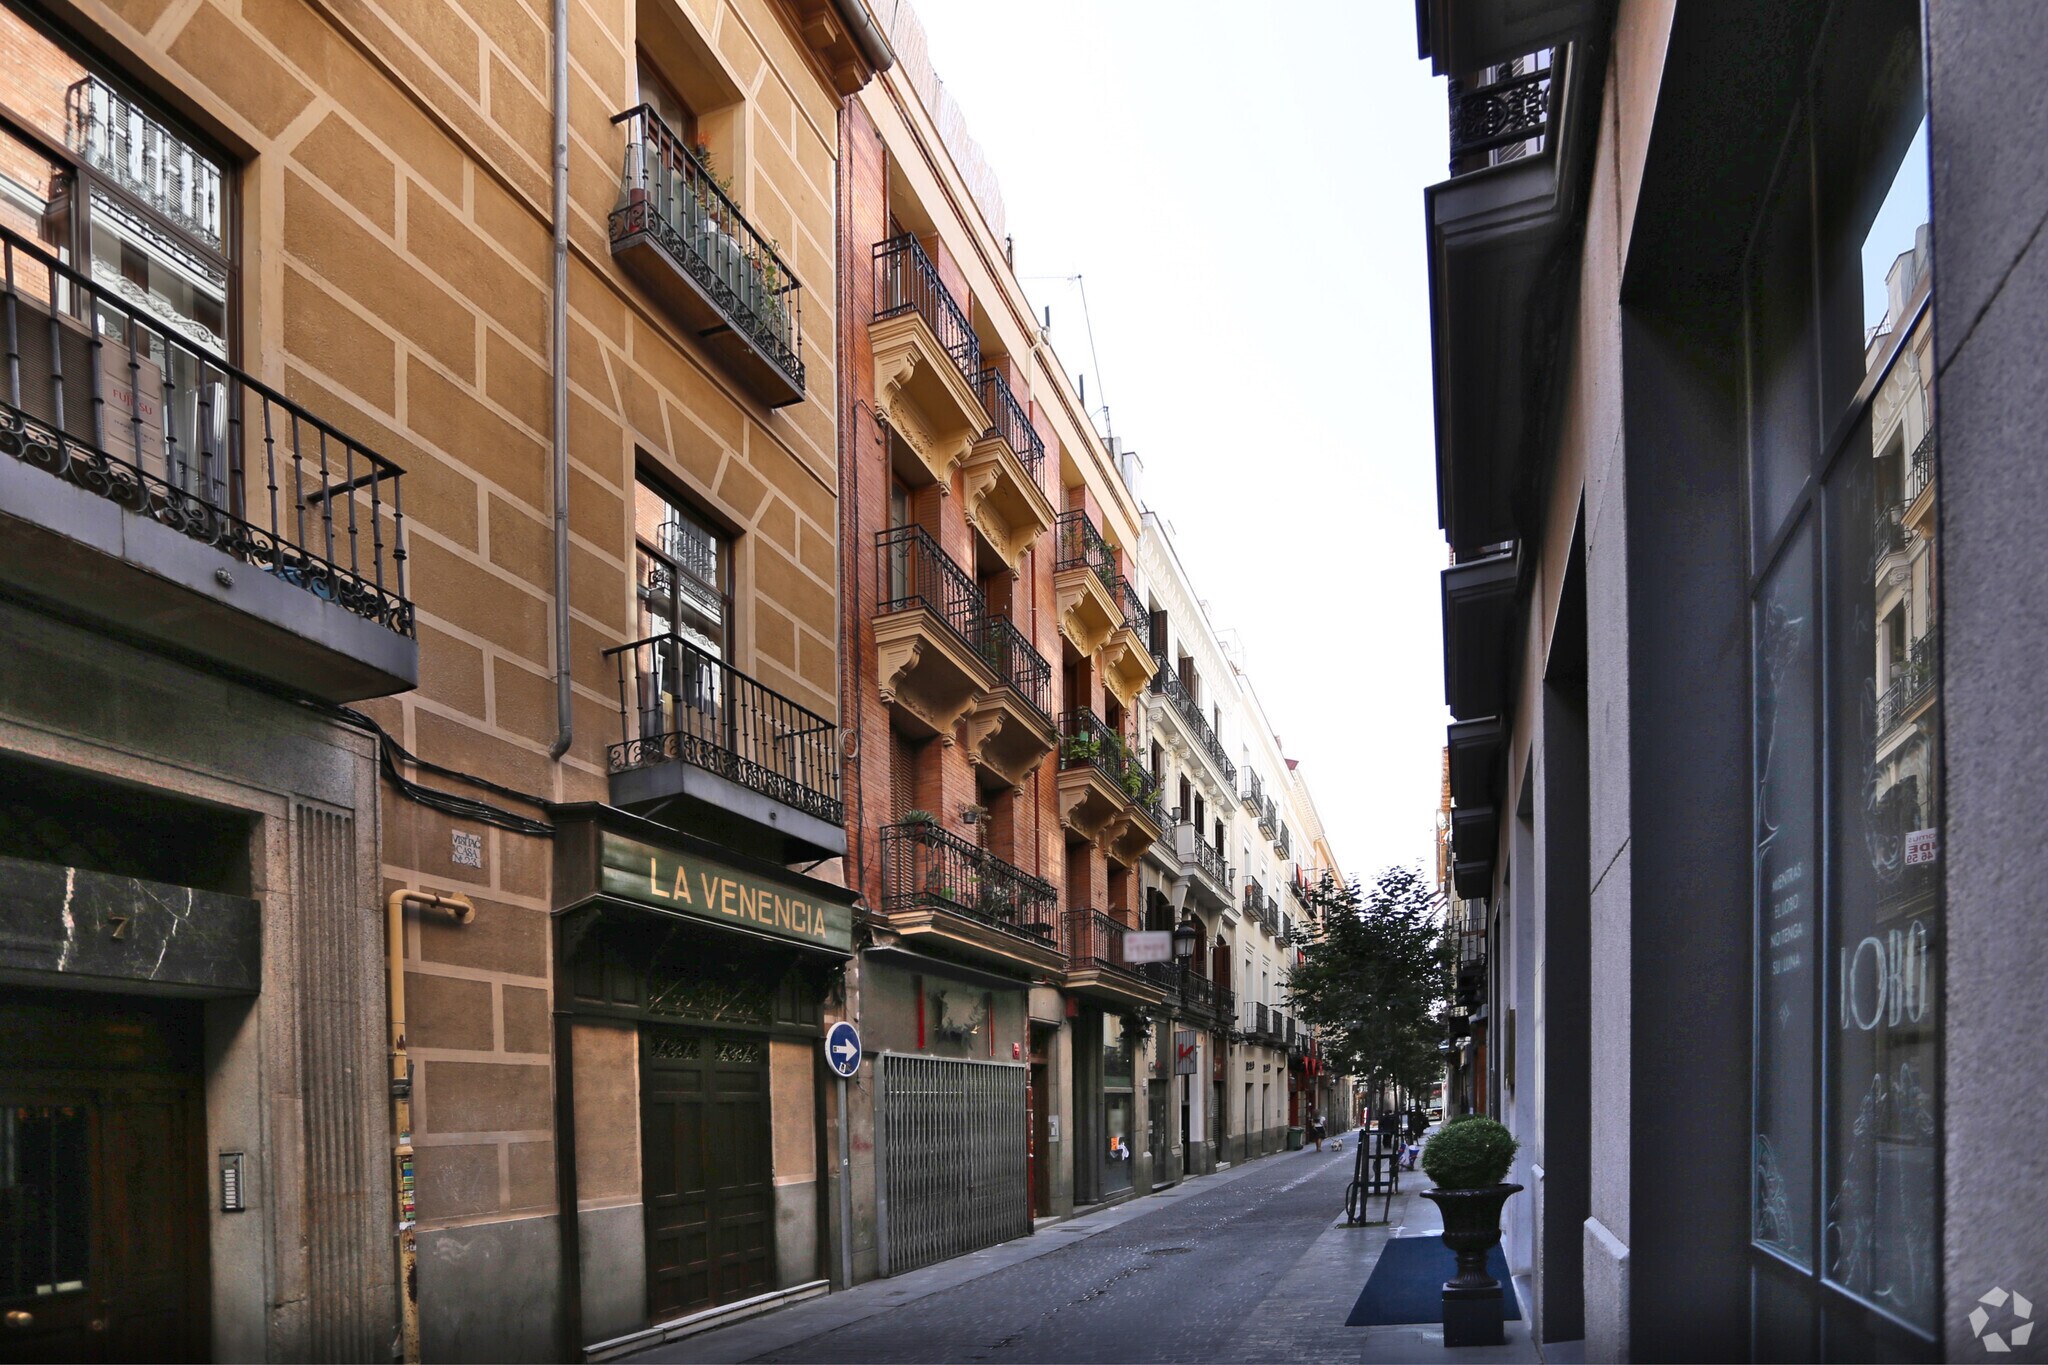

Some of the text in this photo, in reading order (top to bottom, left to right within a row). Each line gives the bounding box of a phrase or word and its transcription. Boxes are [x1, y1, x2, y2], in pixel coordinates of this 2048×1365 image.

[108, 910, 129, 939] 7
[650, 856, 826, 939] LA VENENCIA
